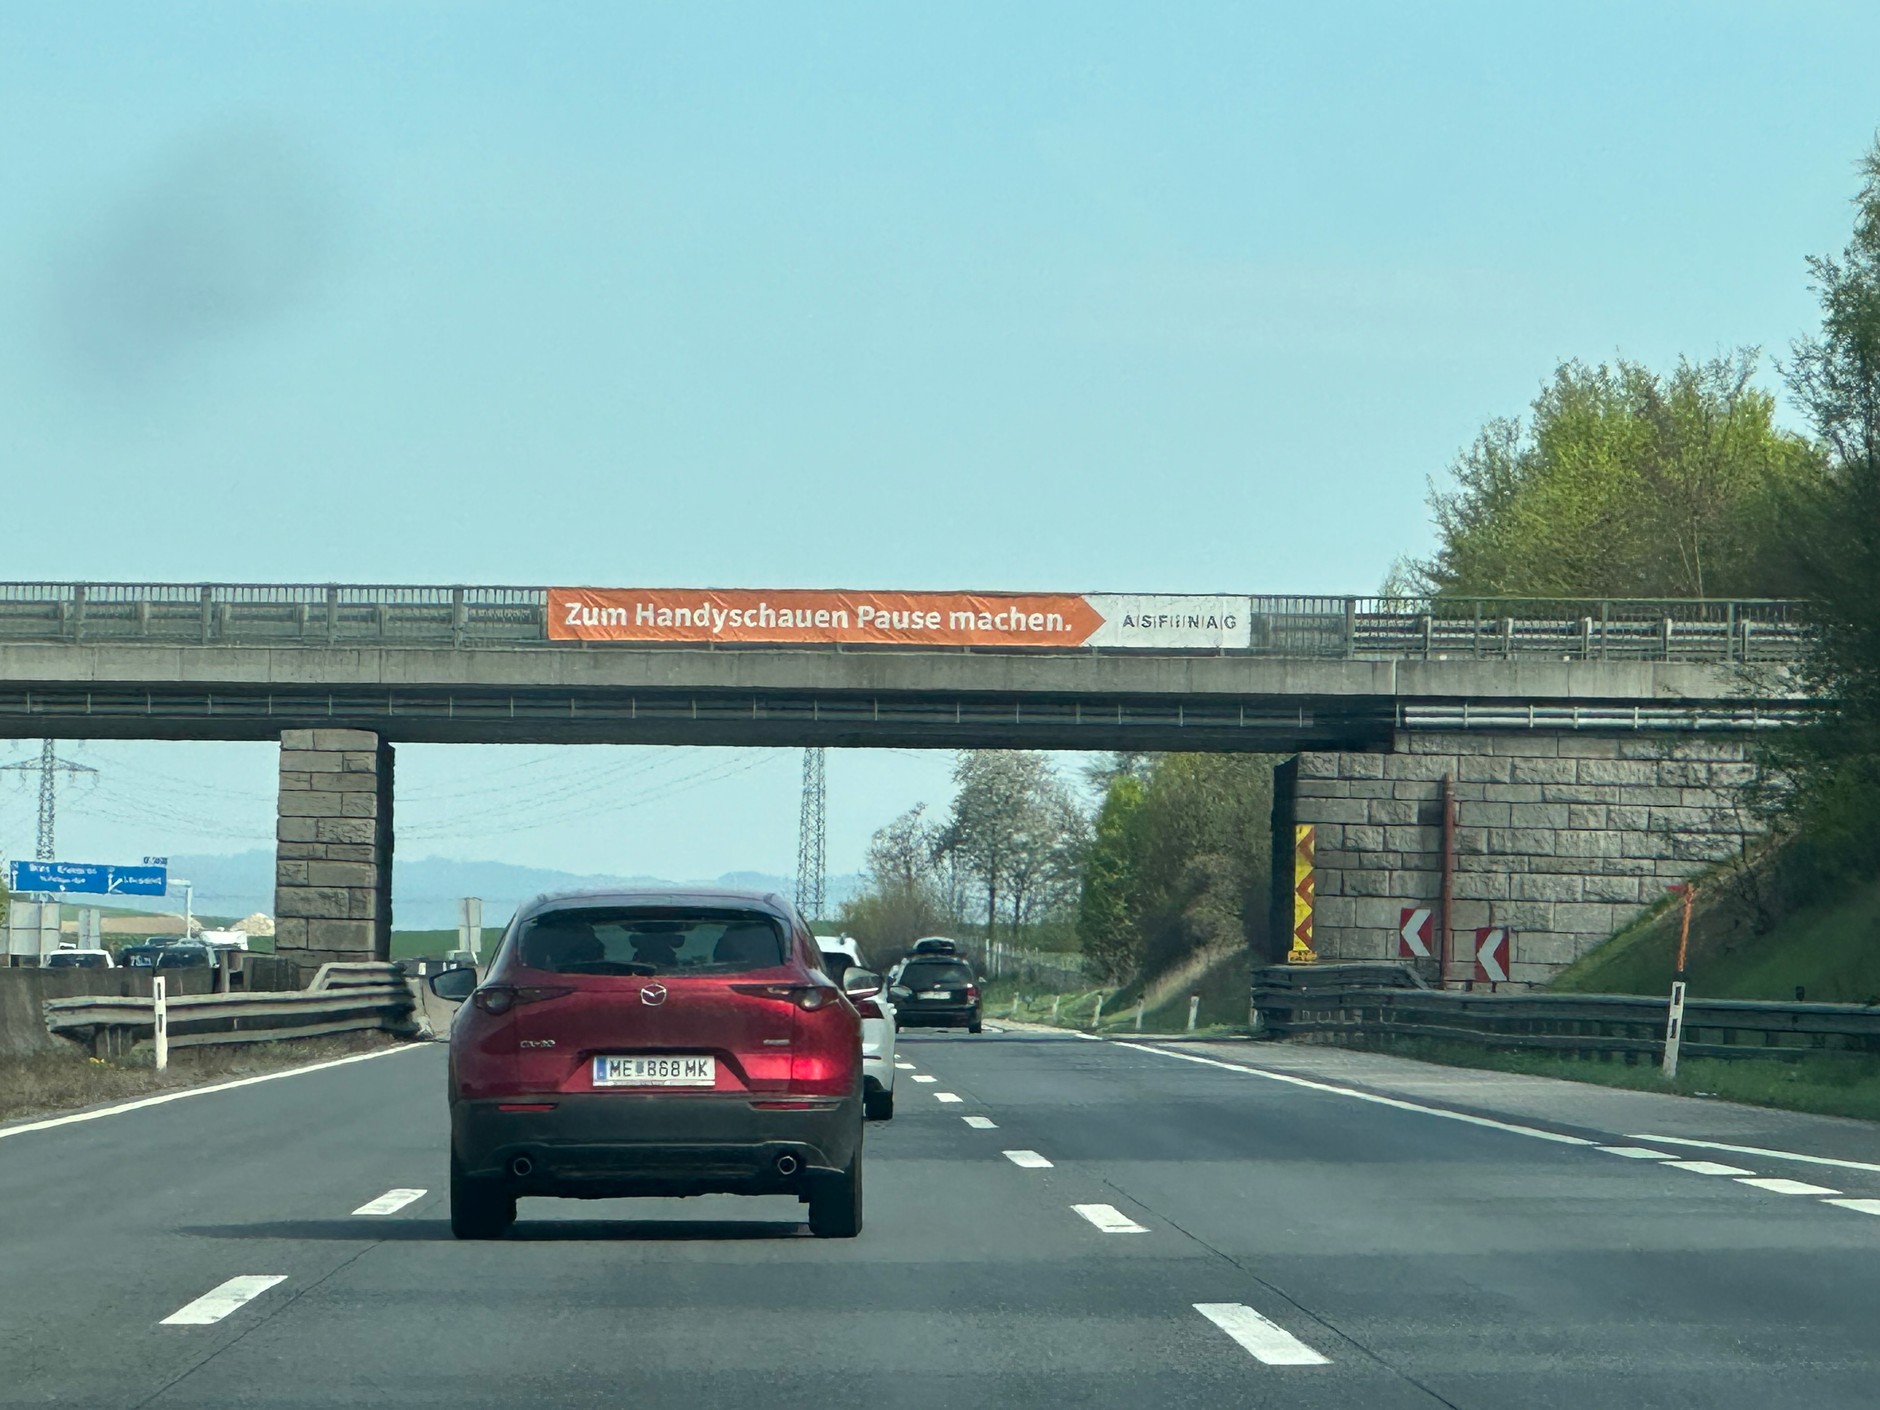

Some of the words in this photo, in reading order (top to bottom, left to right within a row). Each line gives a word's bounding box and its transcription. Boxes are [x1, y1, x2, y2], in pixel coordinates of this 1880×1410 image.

[564, 602, 627, 627] Zum
[635, 602, 849, 633] Handyschauen
[857, 605, 941, 631] Pause
[949, 607, 1072, 632] machen.
